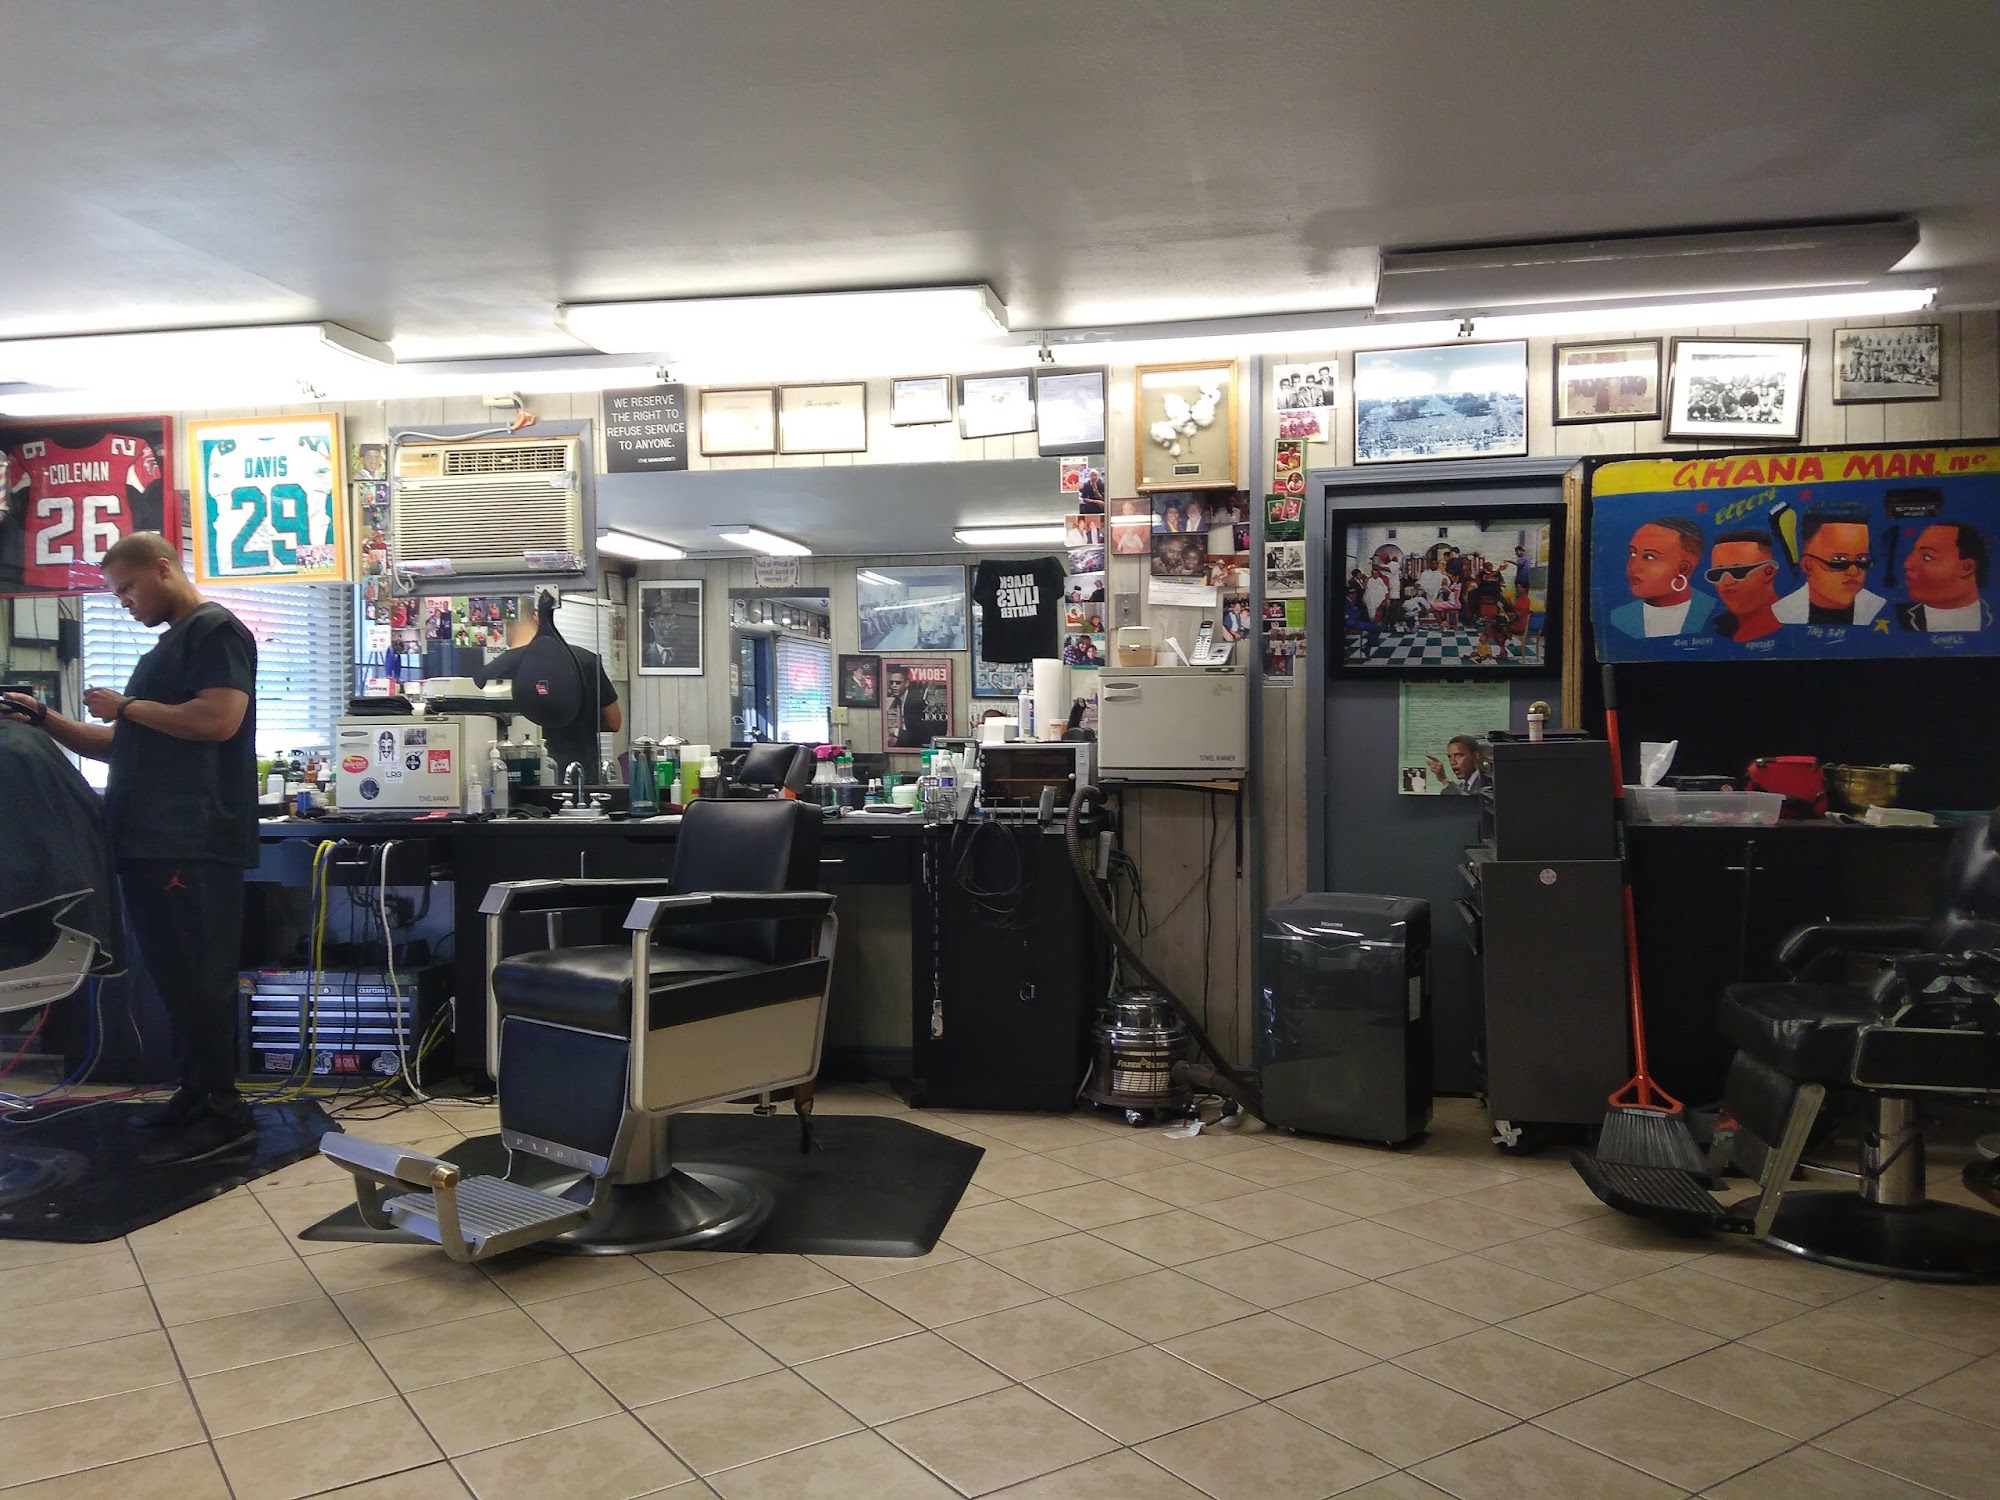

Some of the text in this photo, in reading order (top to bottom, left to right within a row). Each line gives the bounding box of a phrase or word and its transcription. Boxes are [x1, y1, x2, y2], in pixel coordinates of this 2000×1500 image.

[613, 395, 675, 408] WE RESERVE
[611, 409, 679, 422] THE RIGHT TO
[607, 423, 685, 437] REFUSE SERVICE
[619, 438, 676, 450] TO ANYONE.
[50, 461, 110, 485] COLEMAN
[244, 456, 288, 479] DAVIS
[1673, 456, 1824, 489] GHANA
[36, 495, 121, 565] 26
[231, 484, 311, 569] 29
